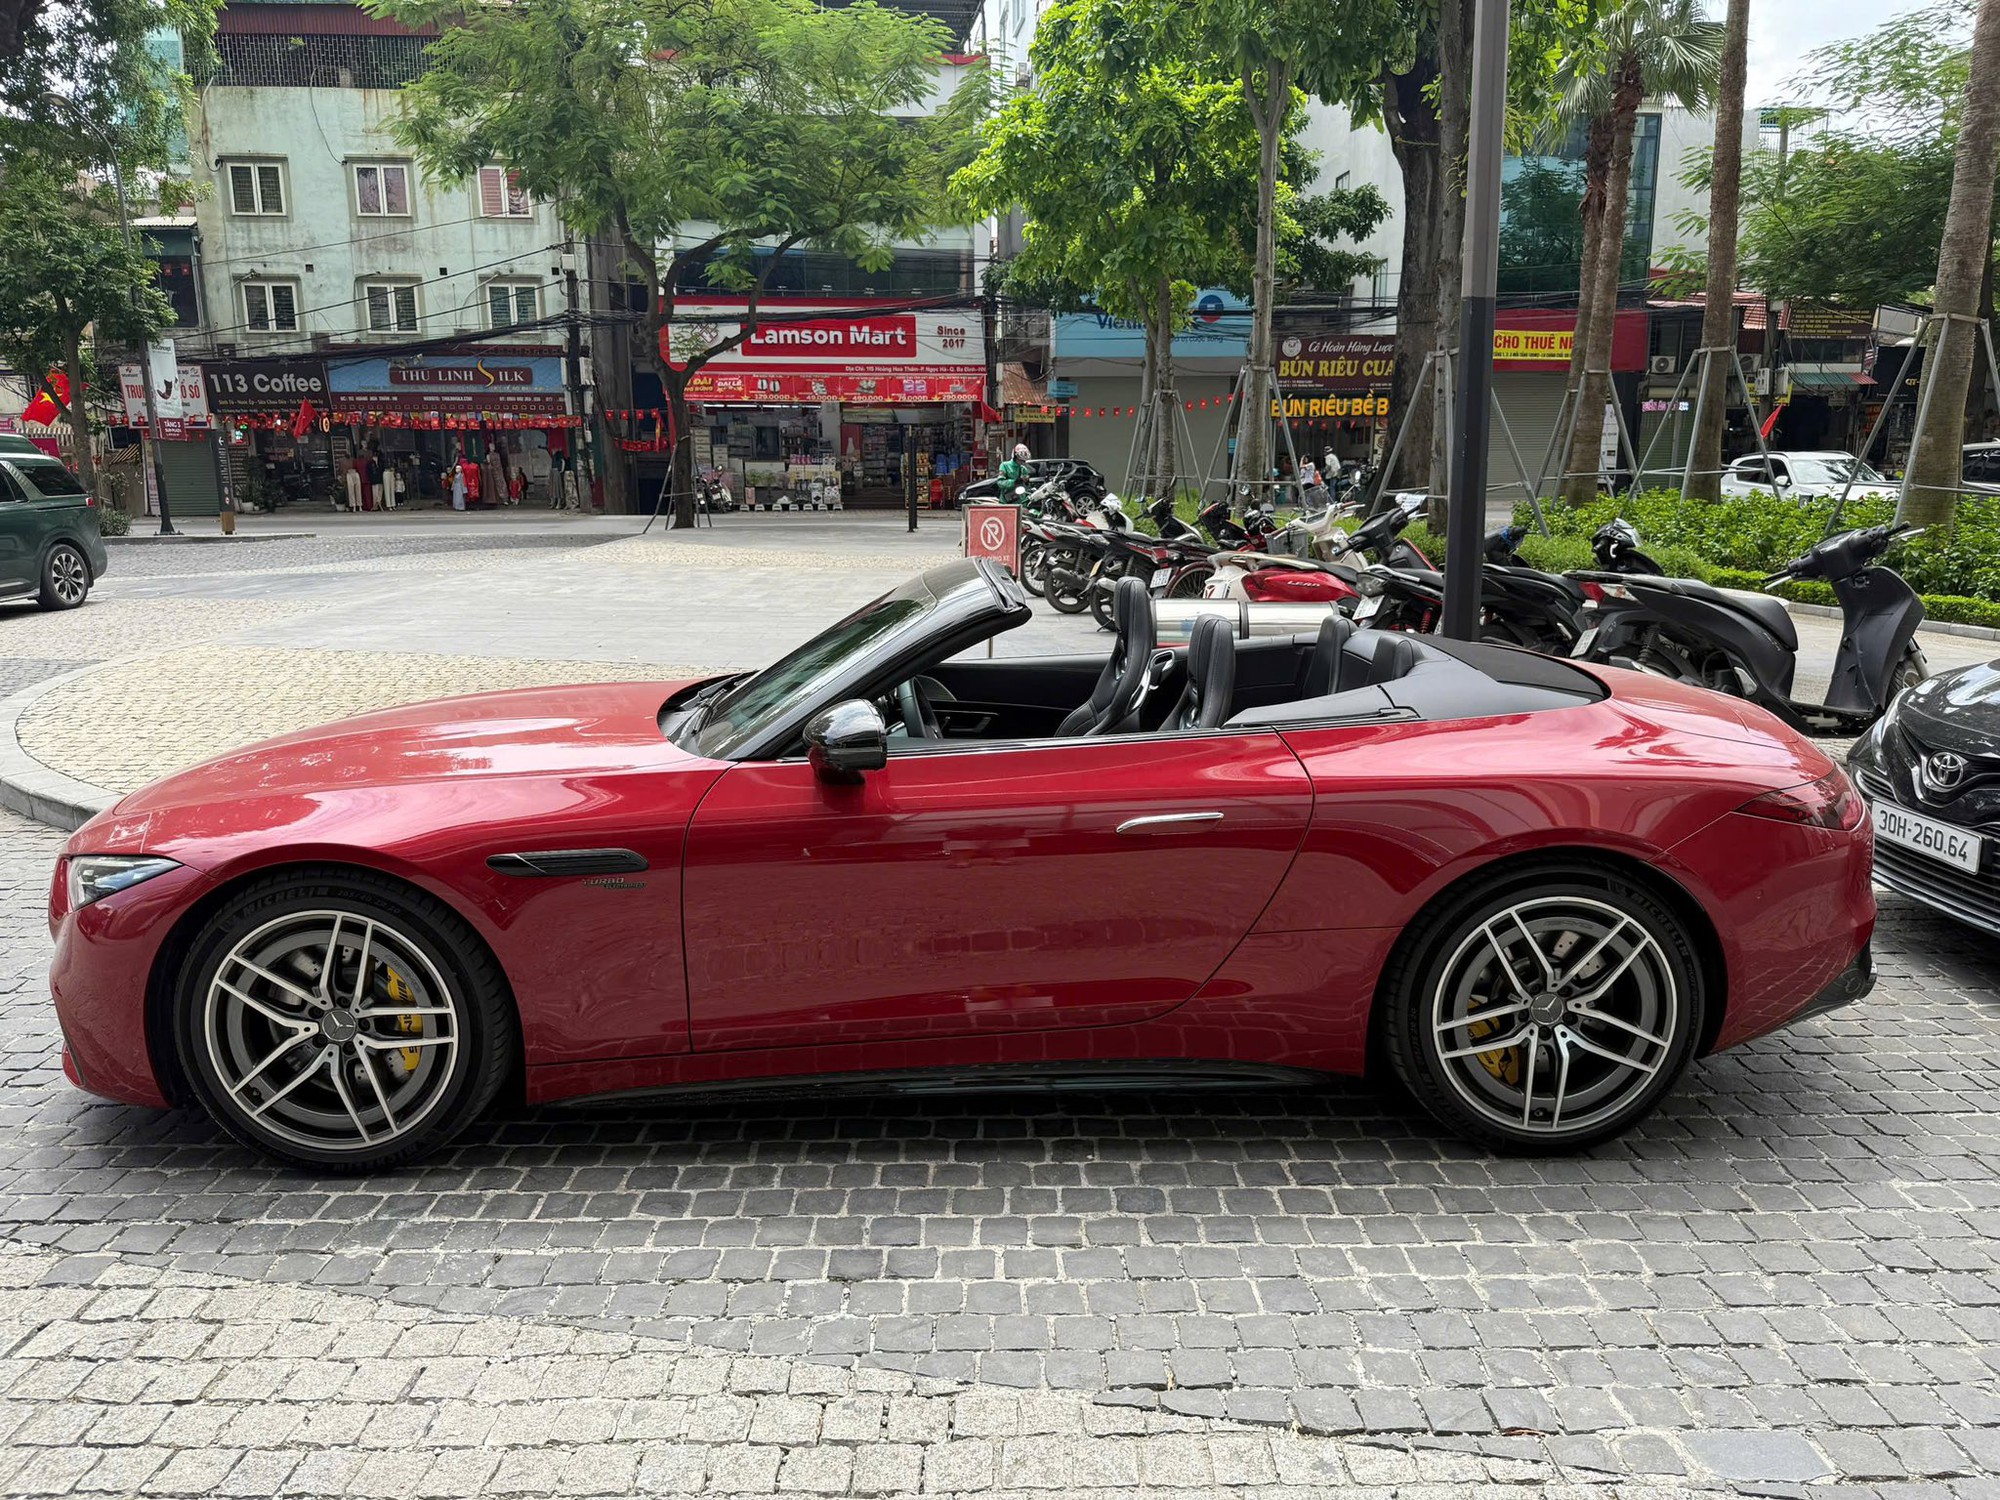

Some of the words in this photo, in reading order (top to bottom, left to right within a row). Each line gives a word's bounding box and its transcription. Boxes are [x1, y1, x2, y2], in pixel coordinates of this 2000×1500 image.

[750, 327, 843, 345] Lamson
[849, 325, 907, 345] Mart
[937, 325, 965, 336] Since
[942, 338, 966, 349] 2017
[1308, 341, 1321, 353] Cô
[1321, 341, 1345, 353] Hoàn
[1346, 341, 1371, 356] Hàng
[1494, 335, 1520, 349] CHO
[1523, 333, 1556, 350] THUÊ
[399, 370, 430, 381] THU
[438, 370, 474, 381] LINH
[477, 359, 525, 389] SILK
[1278, 355, 1315, 377] BÚN
[1317, 355, 1360, 377] RIÊU
[1361, 359, 1394, 377] CUA
[210, 373, 249, 393] 113
[253, 373, 322, 393] Coffee
[1271, 393, 1306, 417] BÚN
[1308, 393, 1349, 417] RIÊU
[1350, 388, 1375, 416] BỀ
[1376, 397, 1391, 416] B
[1878, 809, 1968, 863] 30H-260.64
[583, 877, 624, 886] TURBO
[242, 885, 329, 916] MICHELIN
[1630, 892, 1690, 958] MICHELIN
